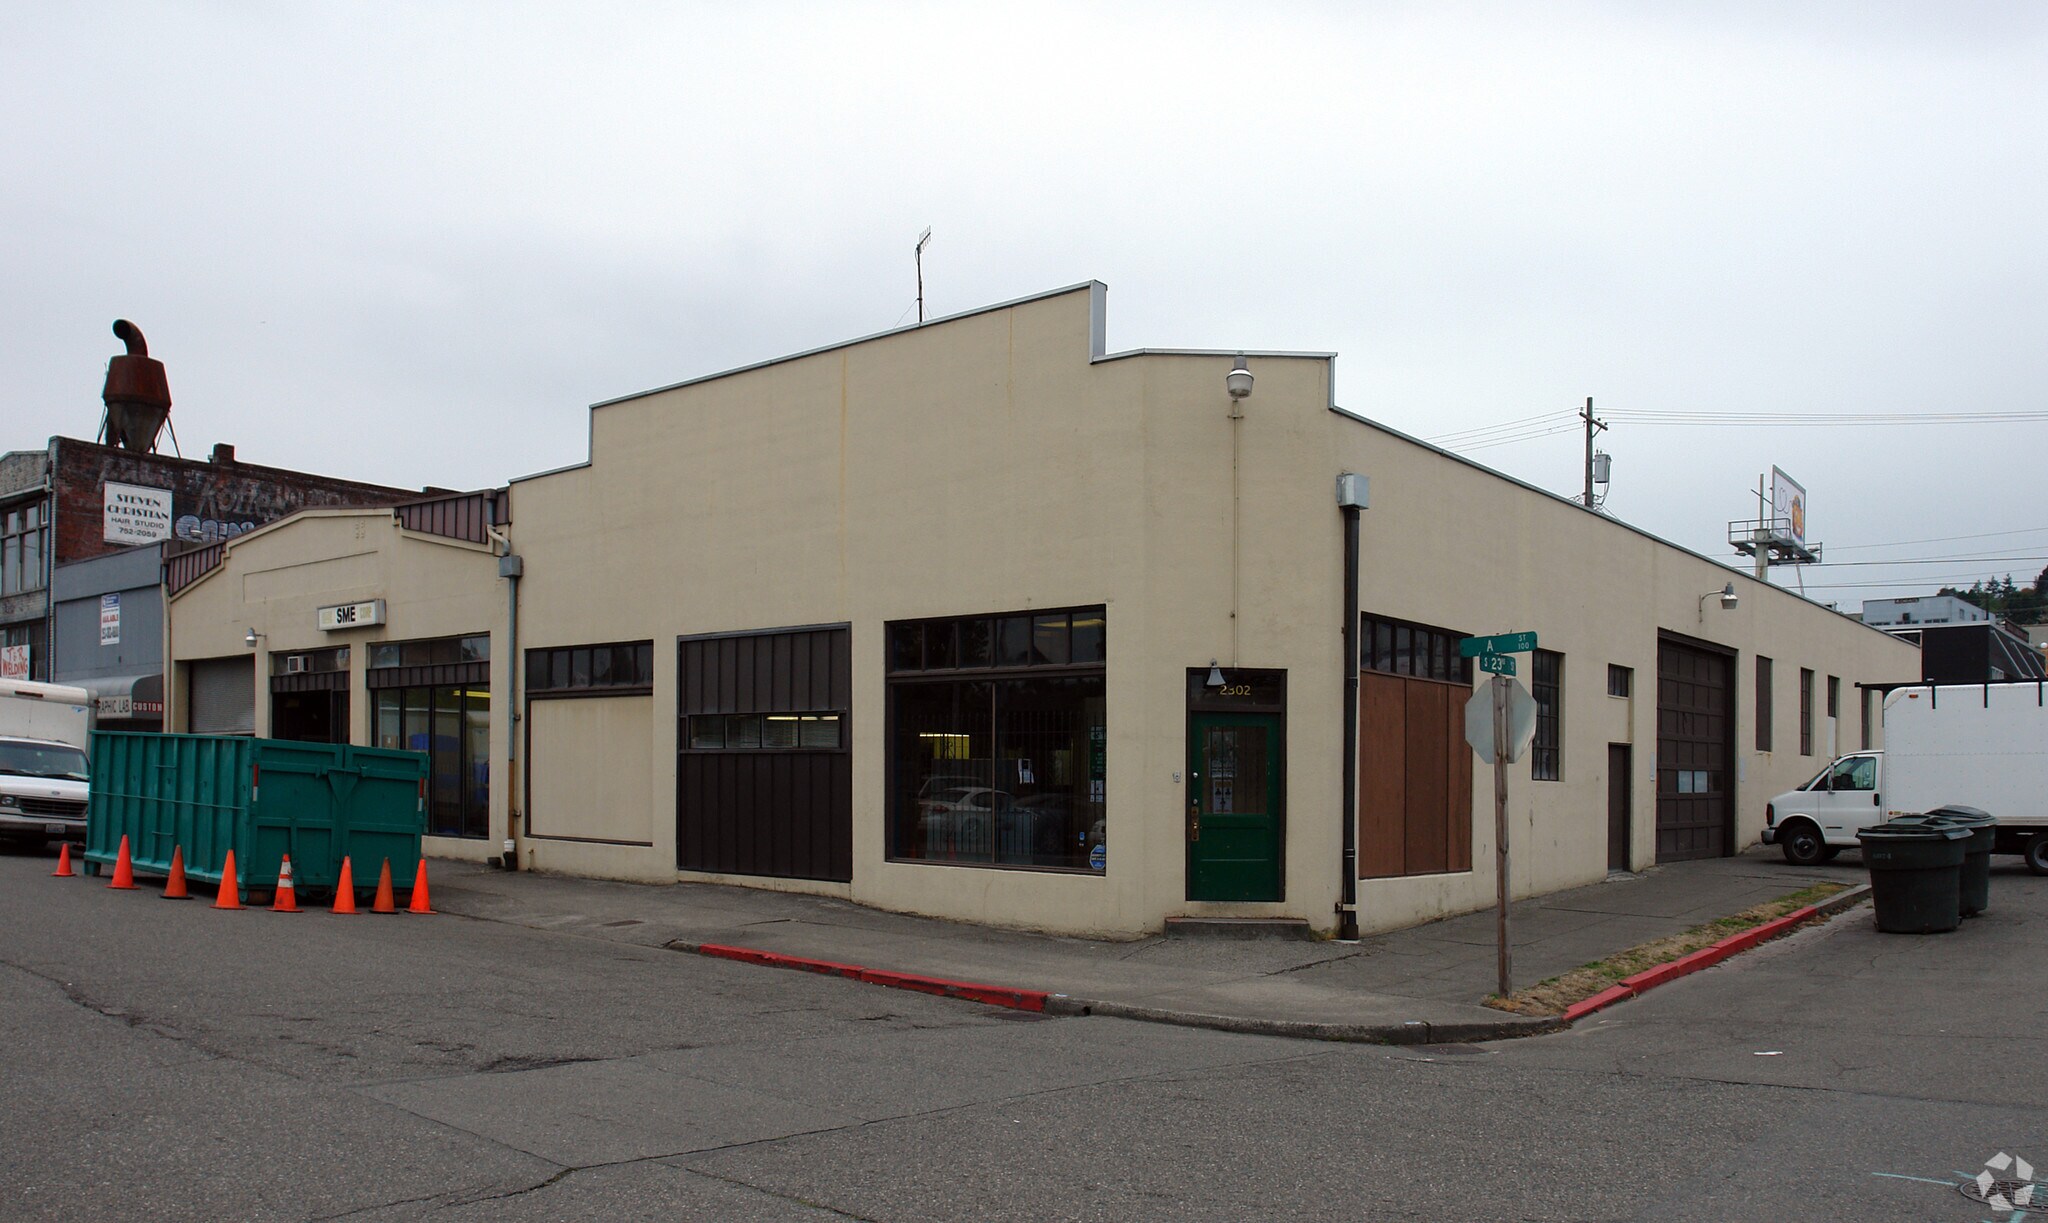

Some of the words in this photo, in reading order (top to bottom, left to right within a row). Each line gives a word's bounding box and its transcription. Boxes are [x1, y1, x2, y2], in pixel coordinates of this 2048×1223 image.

[117, 494, 160, 507] STEVEN
[107, 504, 169, 520] CHRISTIAN
[111, 517, 130, 525] HAIR
[134, 520, 164, 529] STUDIO
[119, 527, 157, 538] 752-2059
[336, 606, 356, 624] SME
[1518, 634, 1526, 642] ST
[1487, 640, 1493, 652] A
[1484, 657, 1488, 667] S
[1219, 684, 1251, 696] 2302
[132, 702, 163, 712] CUSTOM
